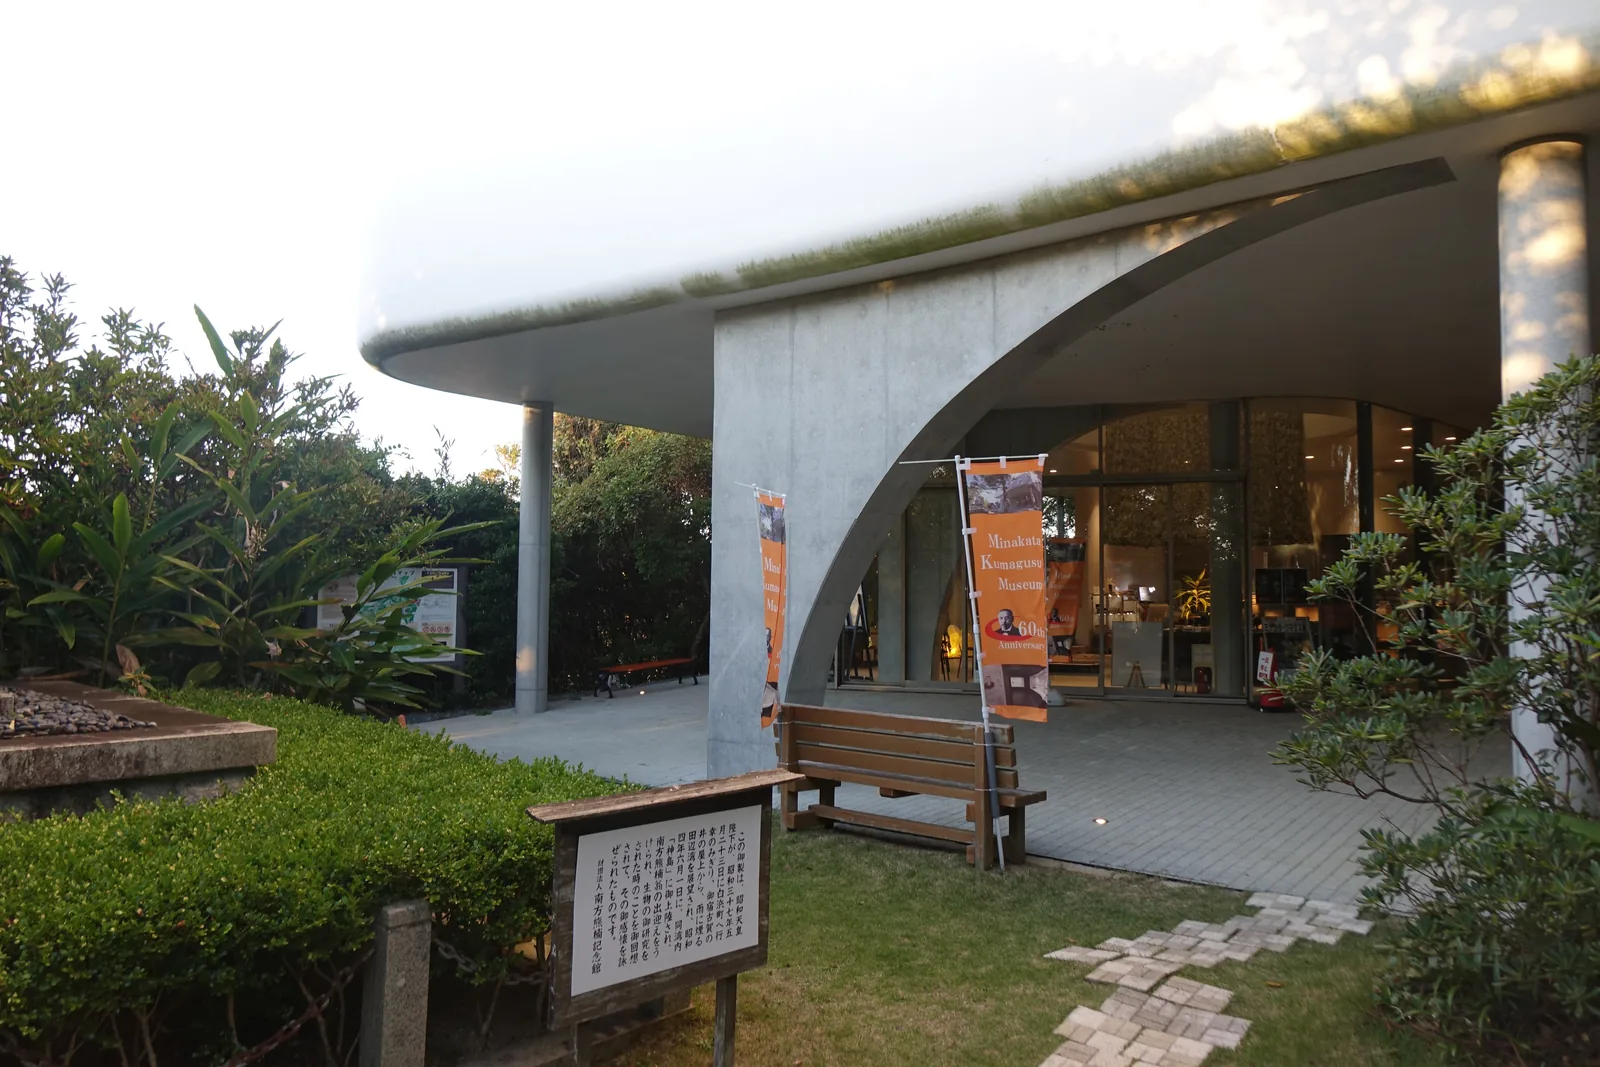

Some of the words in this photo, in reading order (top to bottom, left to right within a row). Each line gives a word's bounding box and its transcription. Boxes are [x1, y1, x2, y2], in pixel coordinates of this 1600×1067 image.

[988, 533, 1042, 549] Minakata
[981, 554, 1042, 571] Kumagusu
[1018, 620, 1046, 638] 60th
